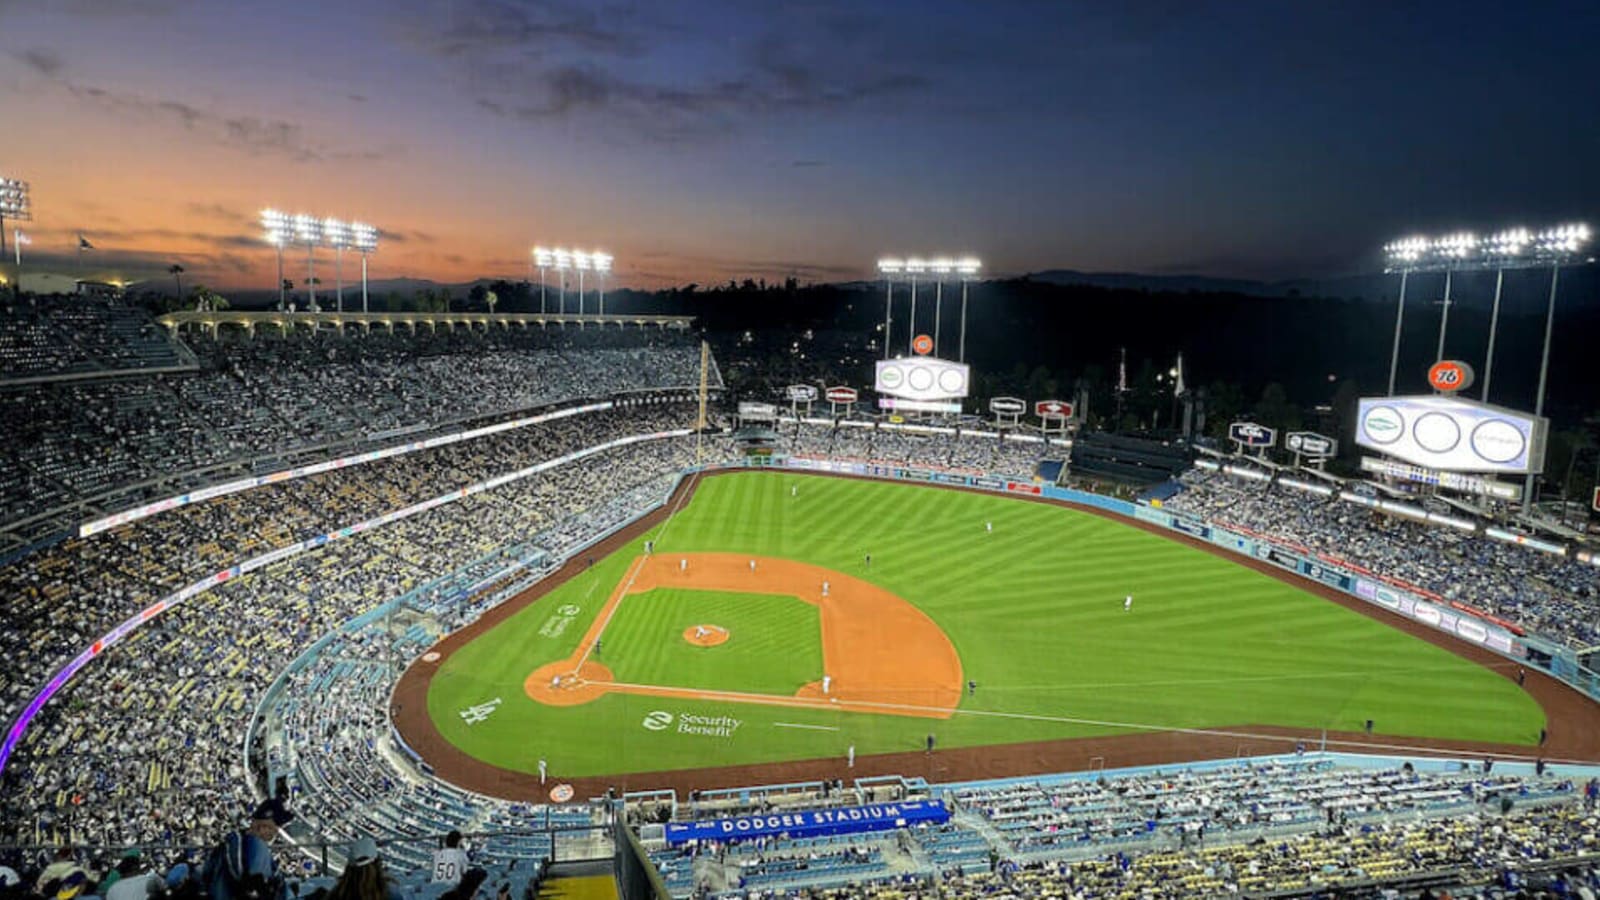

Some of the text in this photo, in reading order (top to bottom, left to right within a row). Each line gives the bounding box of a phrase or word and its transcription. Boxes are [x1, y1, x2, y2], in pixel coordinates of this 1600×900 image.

[1437, 369, 1458, 384] 76
[678, 723, 733, 737] Benefit
[680, 713, 742, 731] Security
[722, 806, 900, 833] DODGER STADIUM
[436, 862, 455, 880] 50
